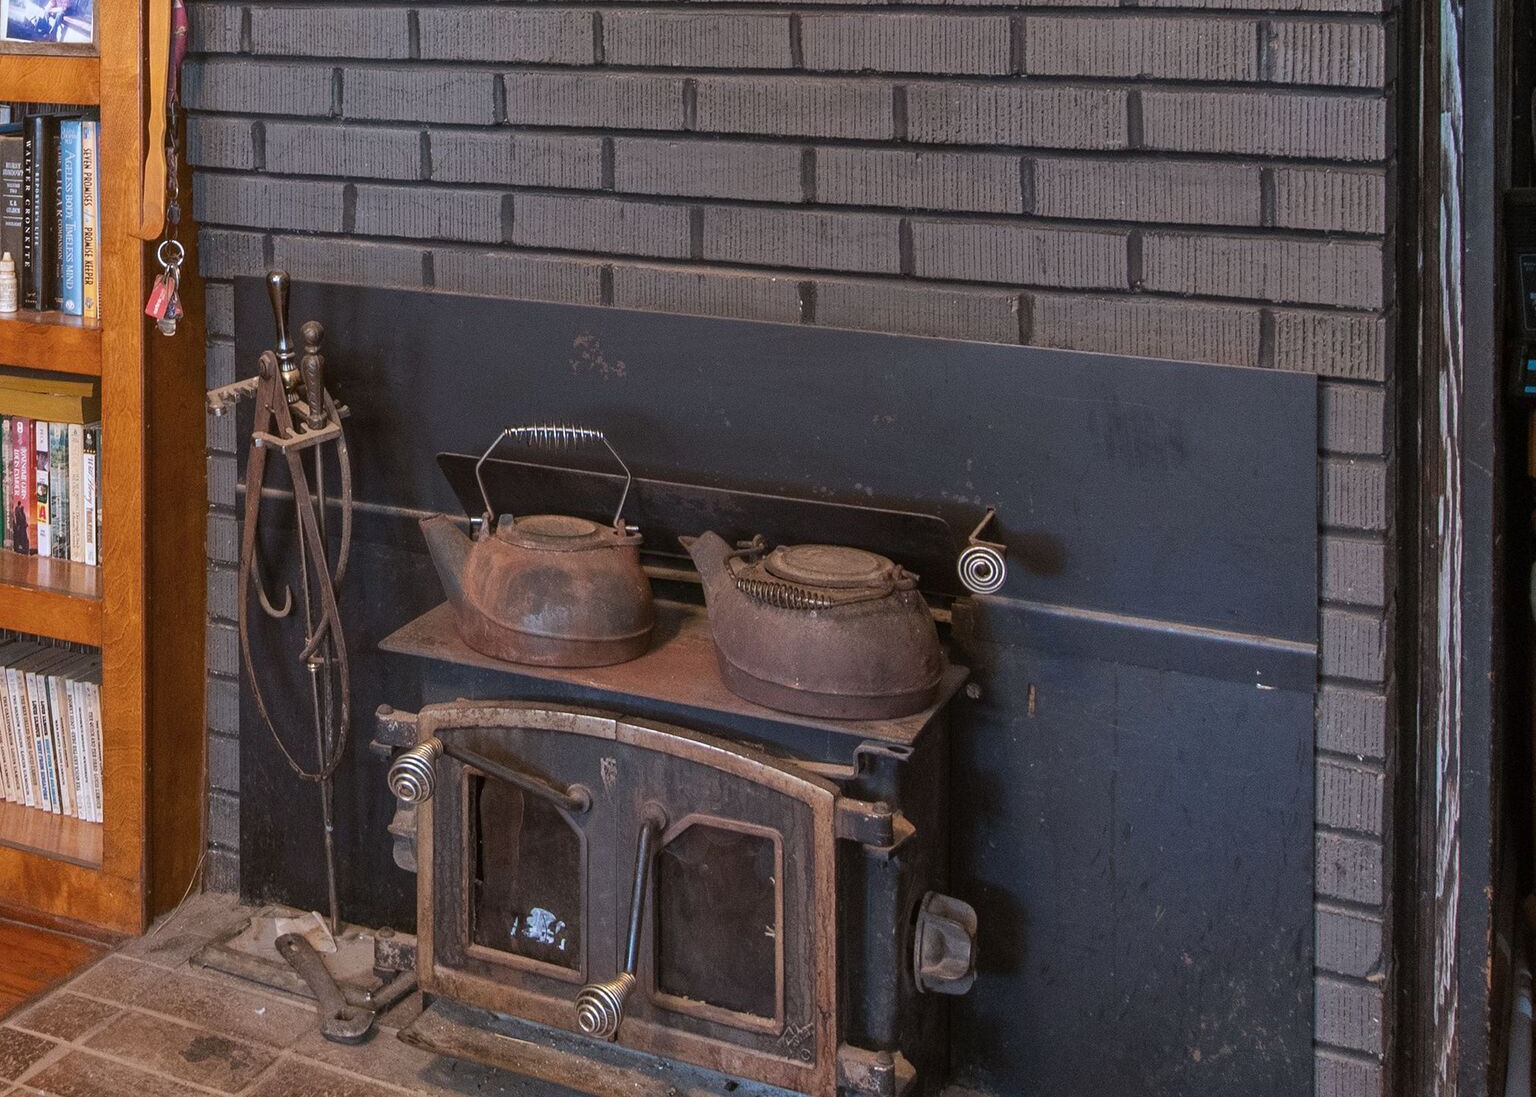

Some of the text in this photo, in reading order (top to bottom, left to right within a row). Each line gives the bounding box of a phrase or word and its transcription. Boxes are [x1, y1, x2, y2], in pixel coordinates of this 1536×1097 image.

[65, 150, 77, 290] AGELESS BODY TIMELESS MIND
[84, 148, 94, 285] SEVEN PROMISES PROMISE KEEPER
